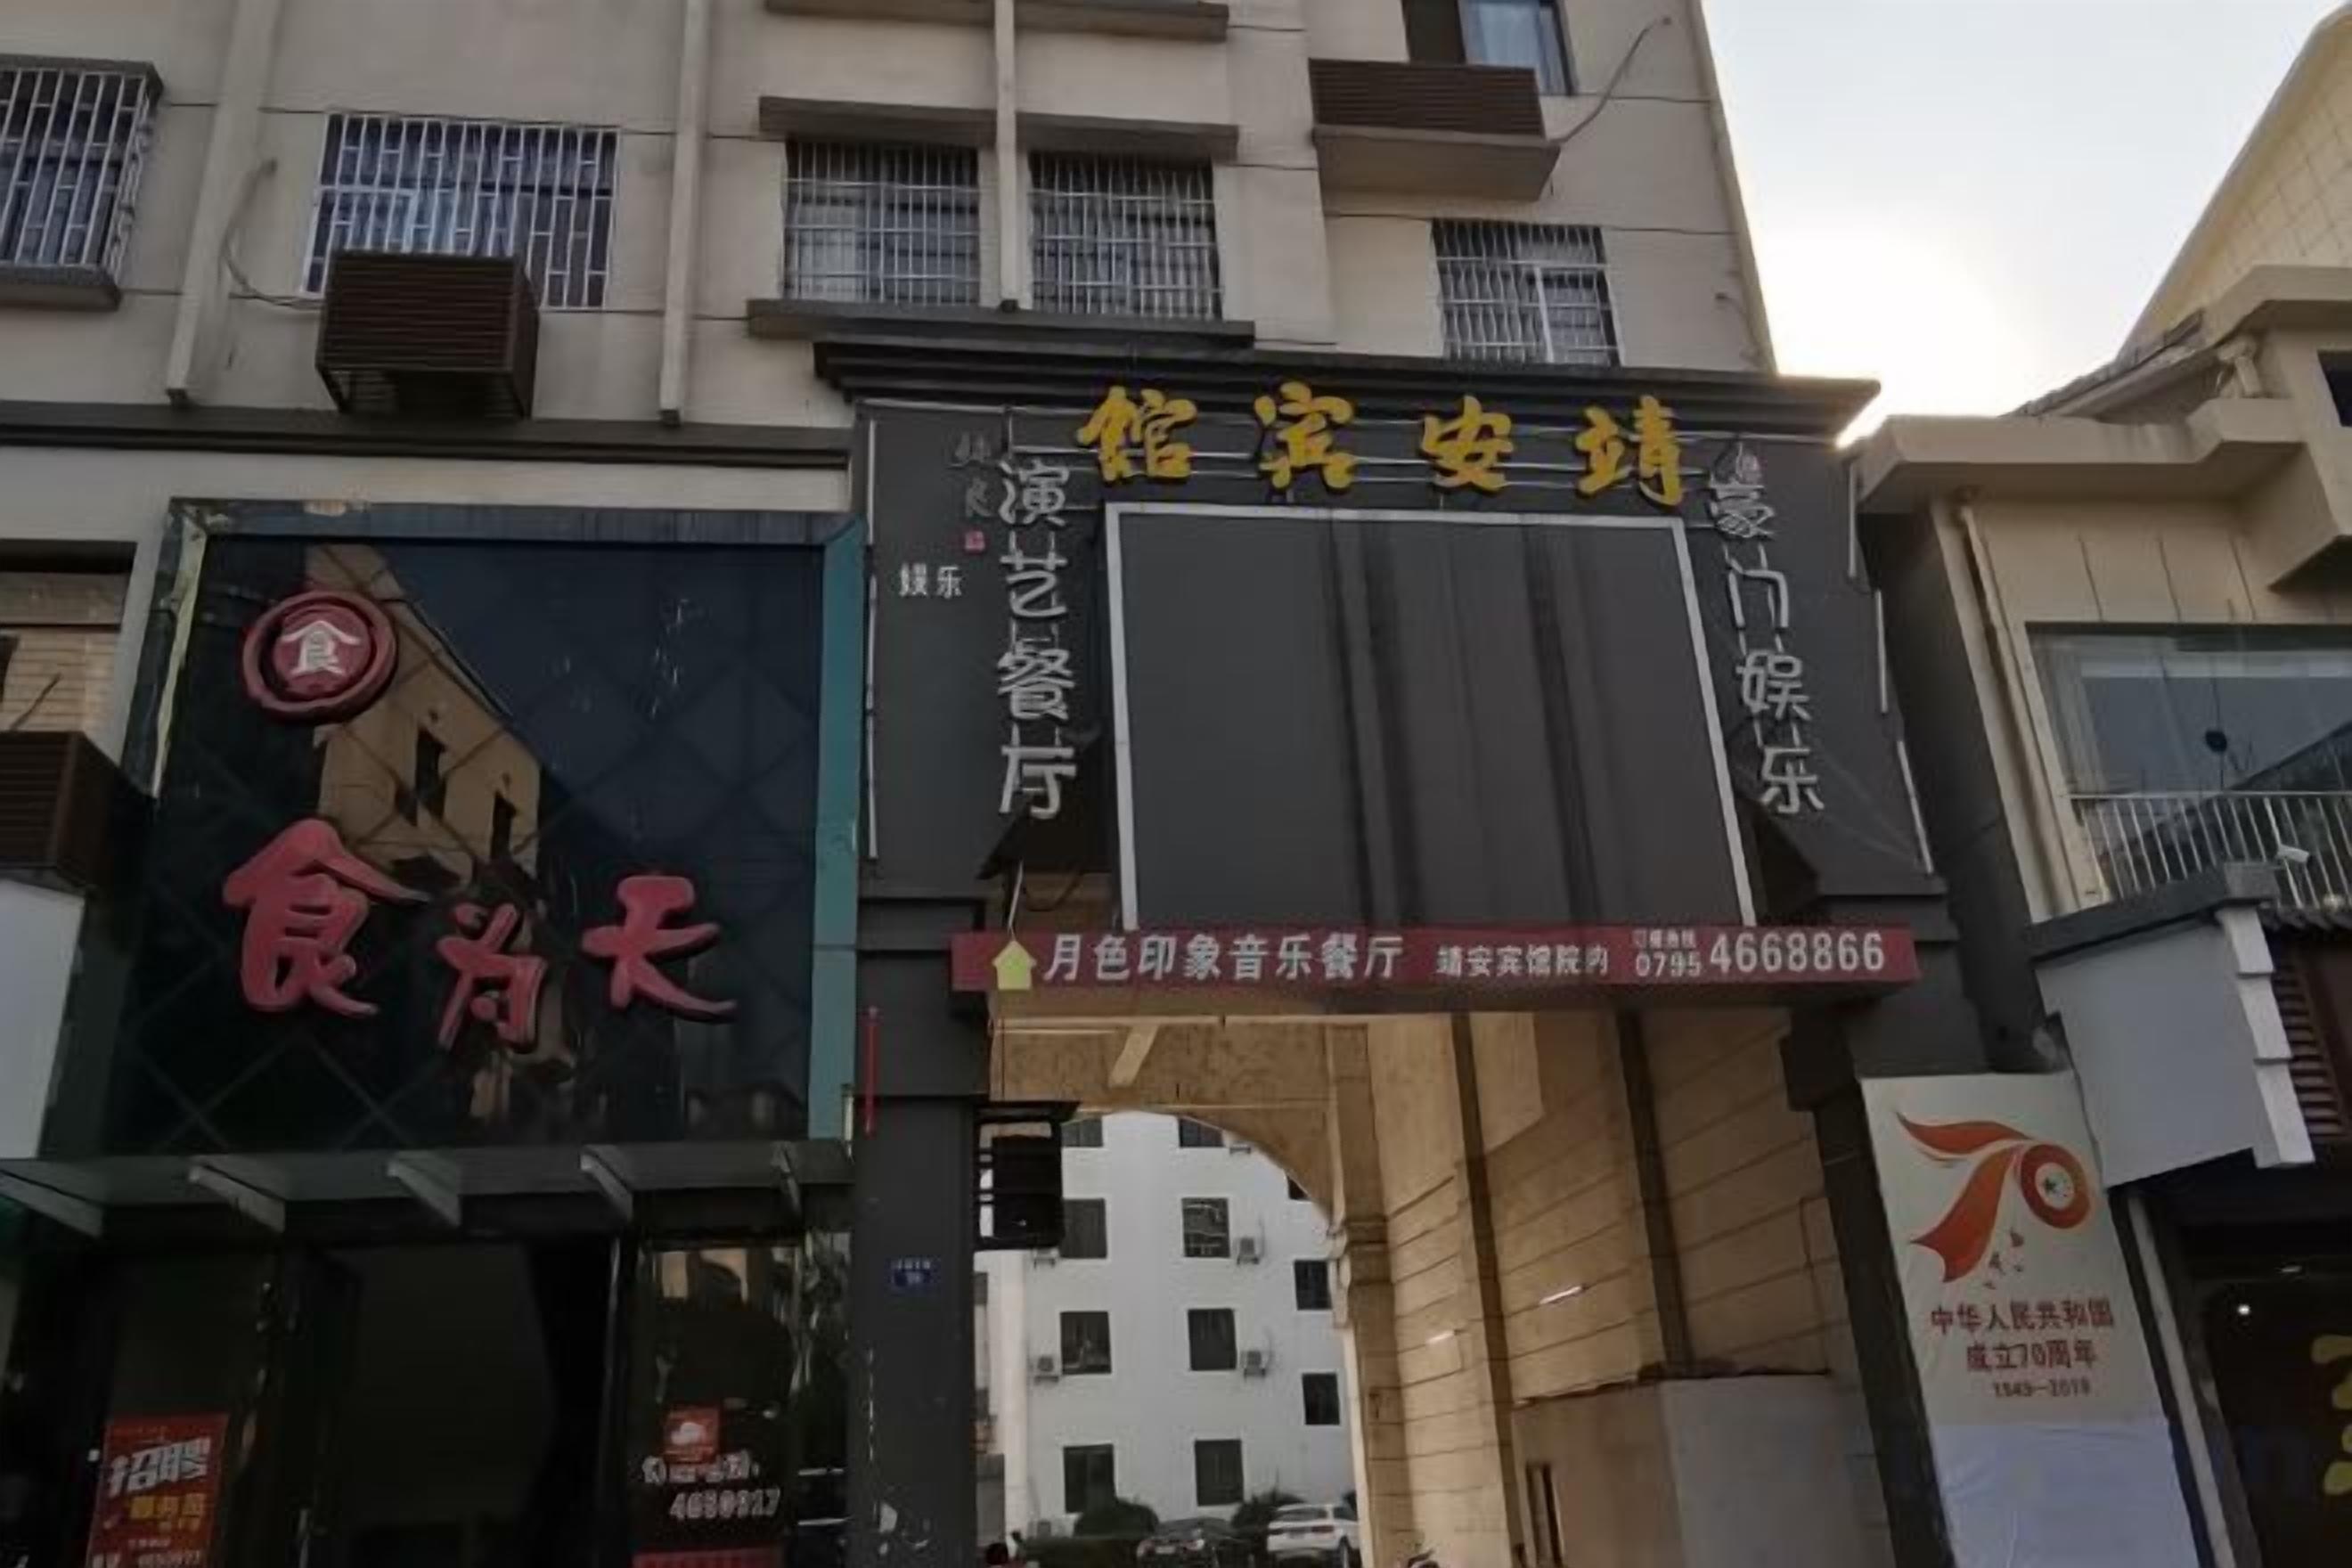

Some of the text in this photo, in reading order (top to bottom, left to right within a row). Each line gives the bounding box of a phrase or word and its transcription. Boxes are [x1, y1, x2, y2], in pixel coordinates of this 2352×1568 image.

[898, 561, 964, 600] 娱乐
[997, 458, 1077, 820] 演艺餐厅
[1710, 474, 1825, 816] 豪门娱乐
[223, 816, 739, 1053] 食为天
[1709, 931, 1885, 974] 4668866
[1043, 933, 1405, 981] 月色印象音乐餐厅
[1436, 943, 1609, 977] 靖安宾馆院内
[1930, 1297, 2114, 1335] 中华人民共和国
[1965, 1339, 2098, 1373] 成立70周年
